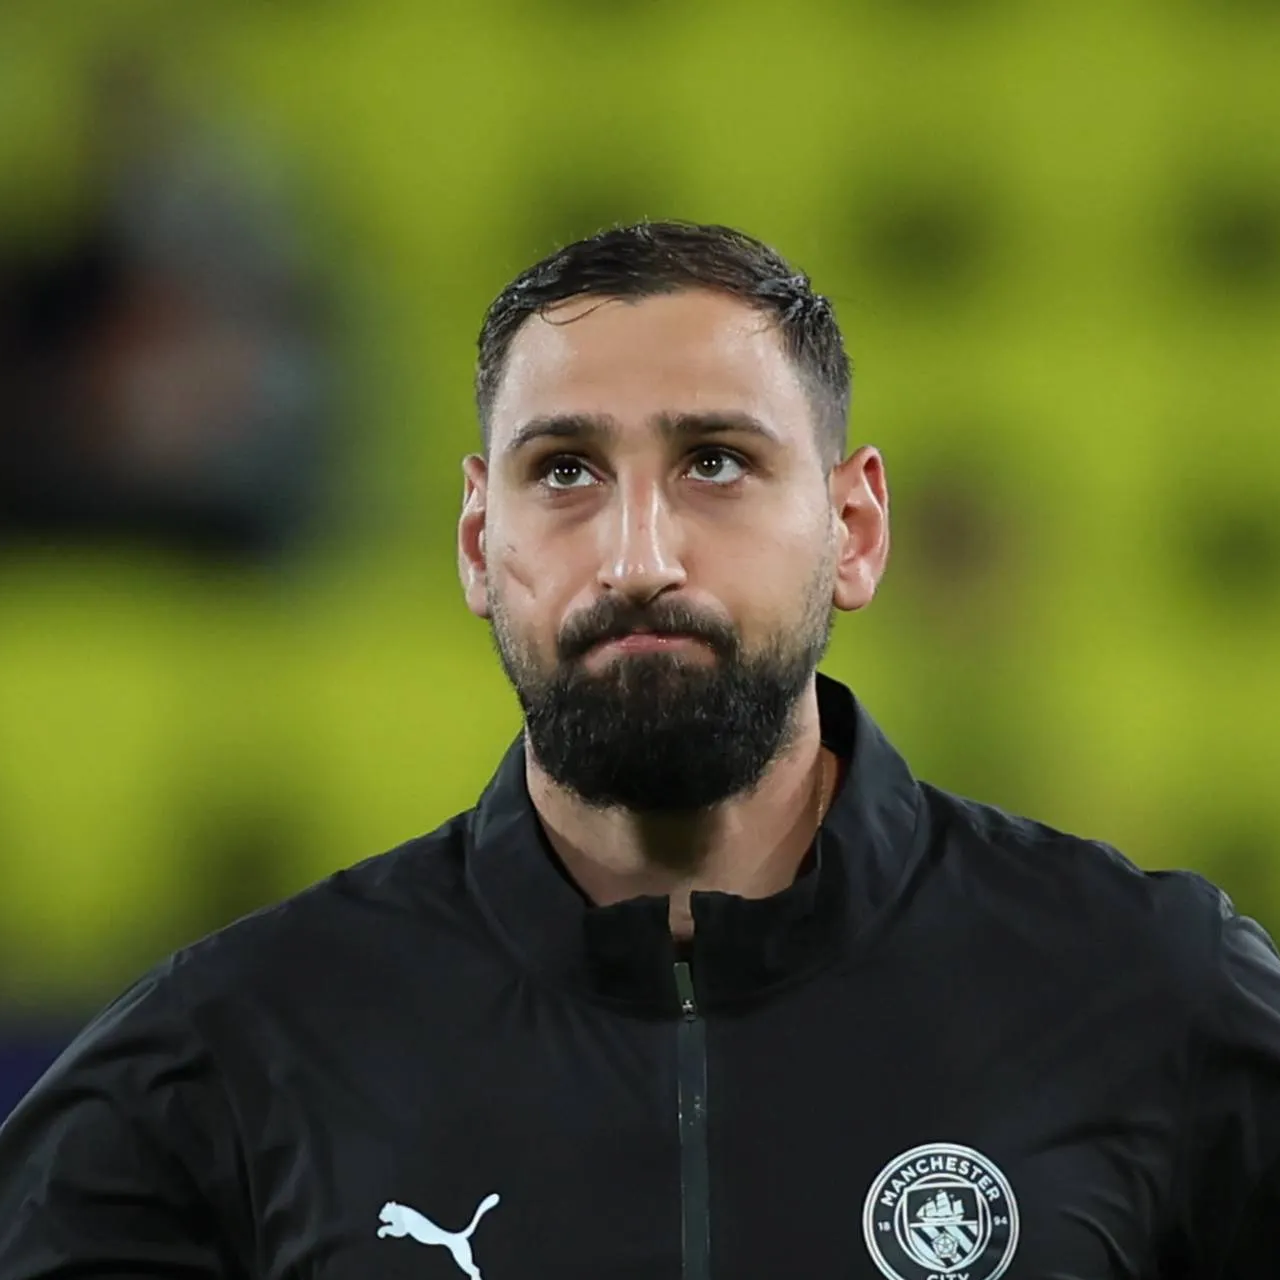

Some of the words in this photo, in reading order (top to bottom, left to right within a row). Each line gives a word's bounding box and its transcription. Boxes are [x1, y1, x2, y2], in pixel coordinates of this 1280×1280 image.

[881, 1156, 1000, 1207] MANCHESTER
[993, 1215, 1008, 1226] 94
[877, 1221, 891, 1232] 18
